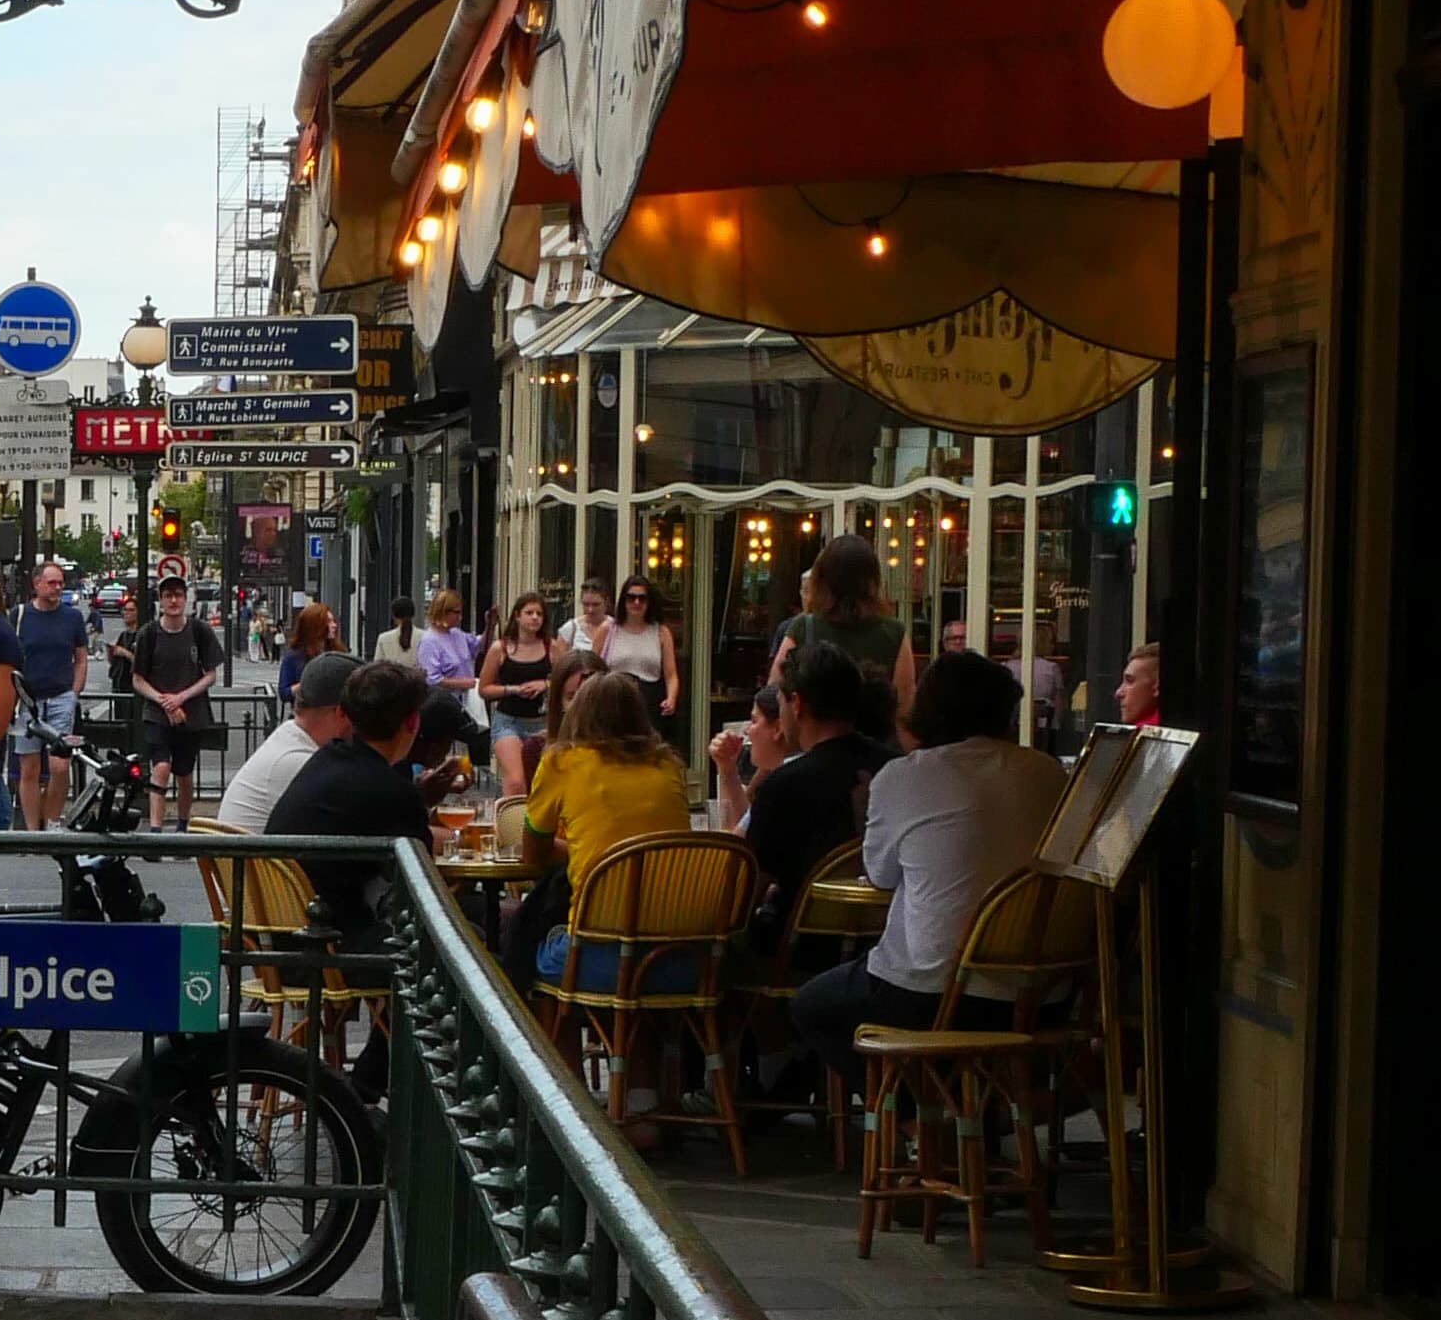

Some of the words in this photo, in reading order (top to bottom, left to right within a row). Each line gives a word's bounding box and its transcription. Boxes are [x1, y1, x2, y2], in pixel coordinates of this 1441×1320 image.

[201, 326, 241, 337] Mairie
[247, 326, 261, 337] du
[201, 342, 287, 354] Commissariat
[219, 358, 238, 367] Rue
[242, 357, 295, 368] Bonaparte
[356, 360, 390, 387] OR
[196, 400, 238, 411] Marché
[263, 398, 310, 409] Germain
[359, 394, 407, 415] ANGE
[209, 414, 227, 423] Rue
[231, 413, 276, 422] Lobineau
[197, 449, 232, 463] Église
[258, 451, 309, 462] SULPICE
[307, 517, 336, 529] VANS
